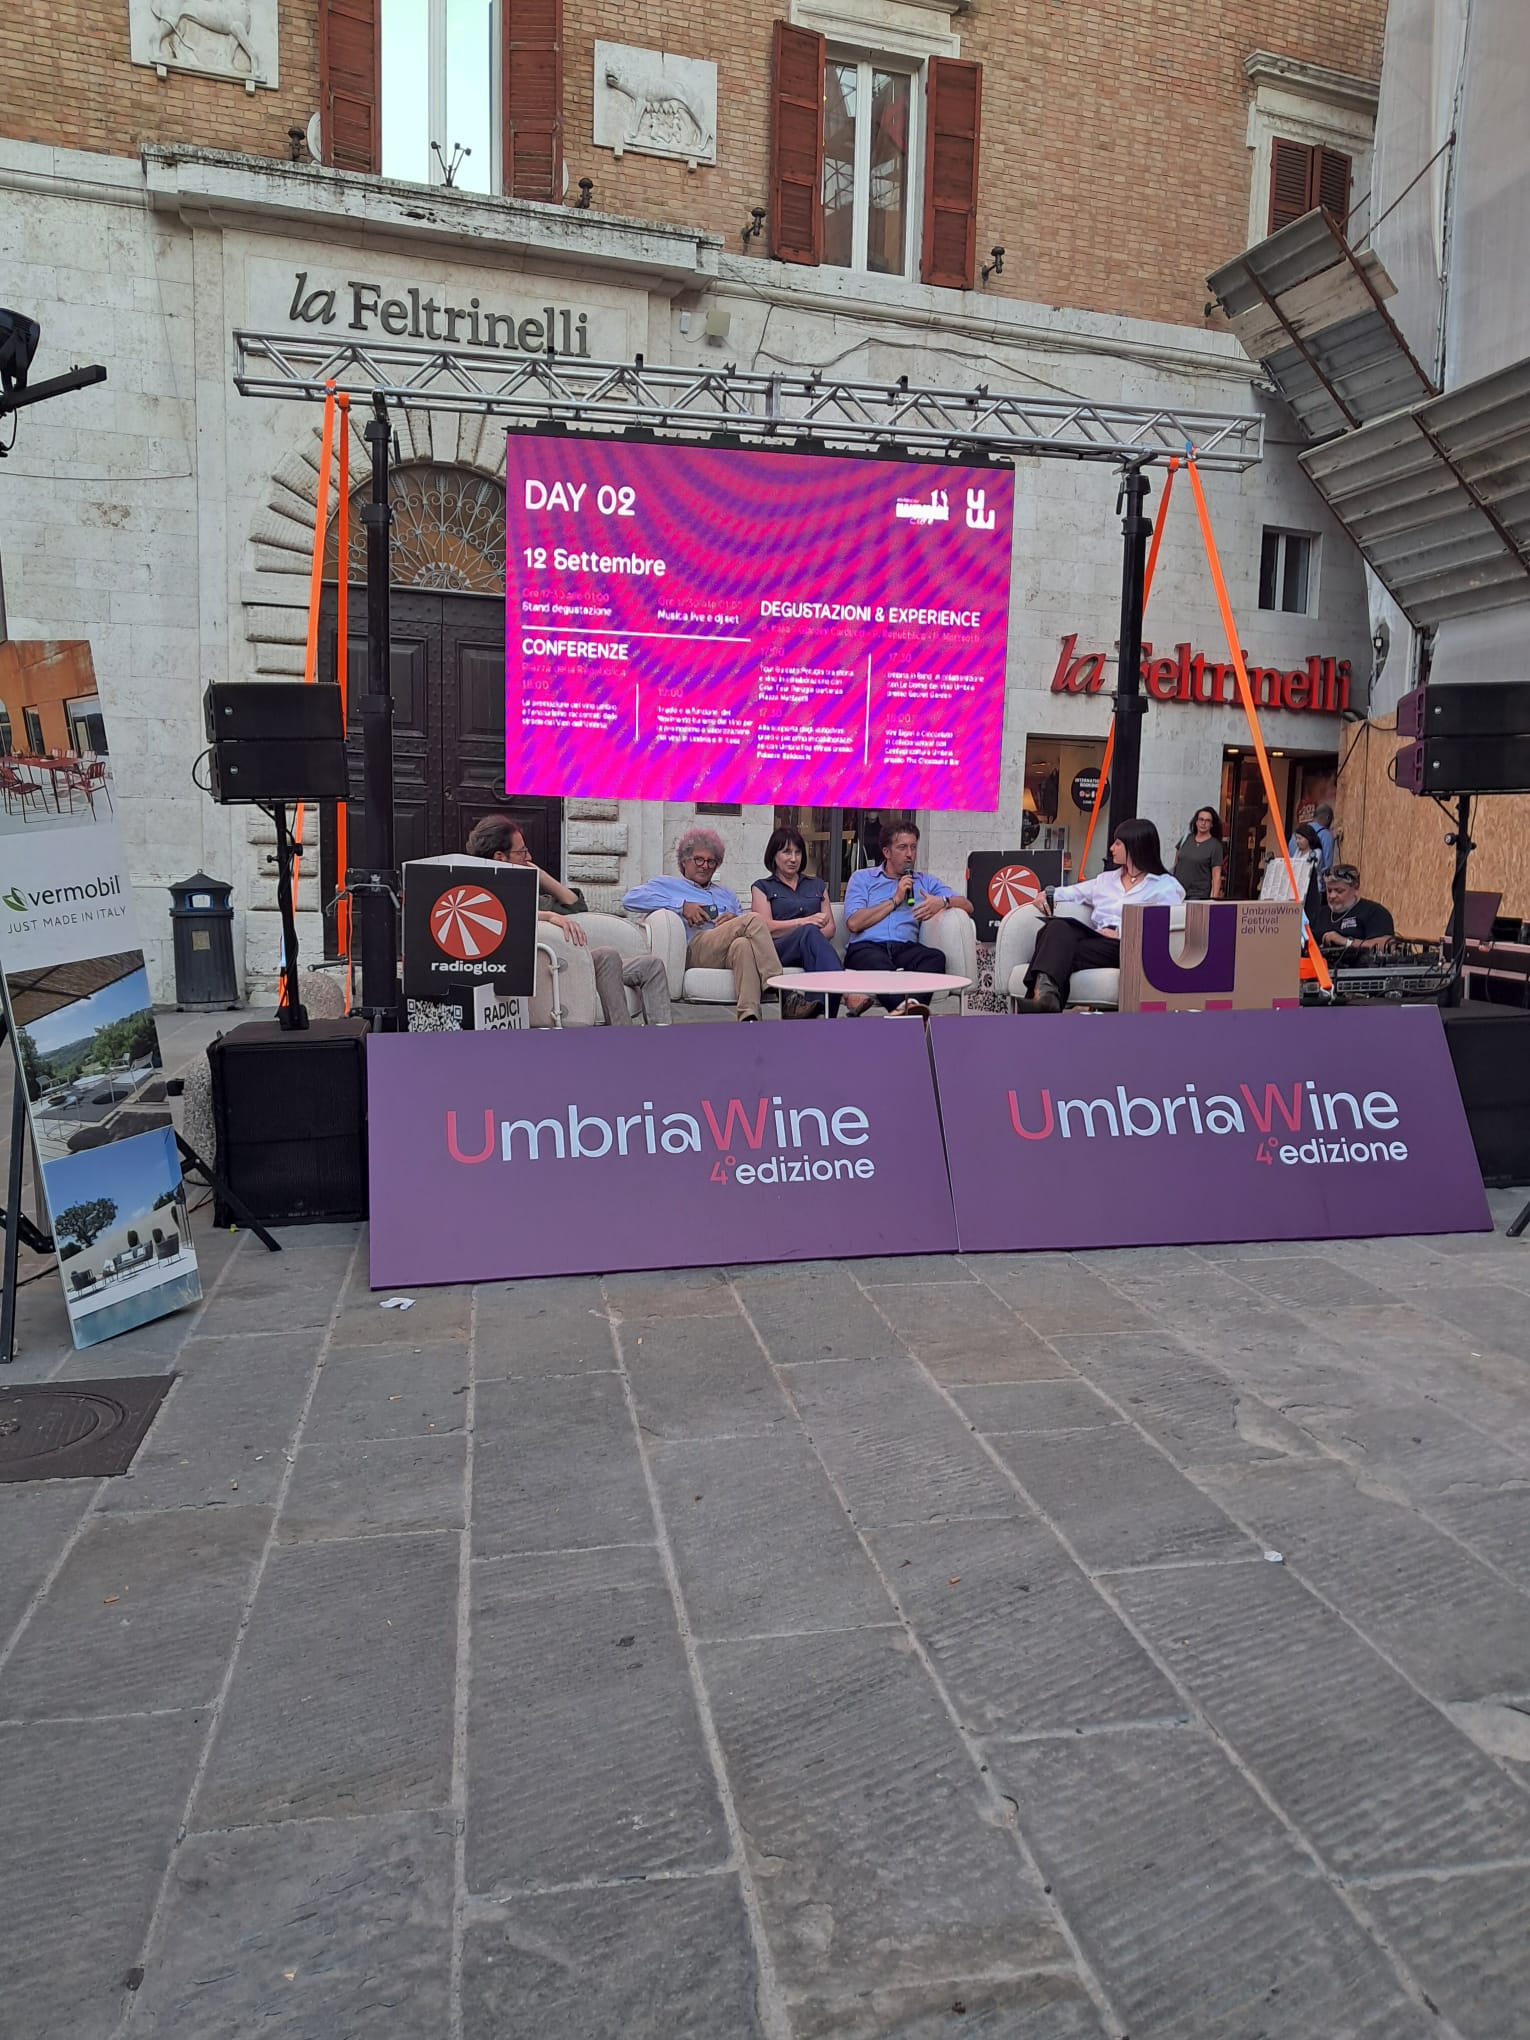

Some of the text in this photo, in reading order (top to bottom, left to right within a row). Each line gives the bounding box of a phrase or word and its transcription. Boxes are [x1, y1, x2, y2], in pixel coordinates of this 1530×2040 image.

[289, 272, 591, 358] la Feltrinelli
[525, 479, 636, 516] DAY 02
[523, 548, 666, 576] 12 Settembre
[522, 601, 613, 616] Stand degustazione
[760, 600, 981, 627] DEGUSTAZIONI & EXPERIENCE
[522, 638, 629, 660] CONFERENZE
[1051, 633, 1107, 695] la
[28, 874, 121, 906] vermobil
[8, 905, 127, 934] JUST MADE IN ITALY
[1241, 906, 1300, 916] UmbriaWine
[1241, 916, 1279, 925] Festival
[1258, 926, 1280, 934] Vino
[431, 960, 507, 975] radioglox
[484, 998, 520, 1024] RADICI
[1008, 1080, 1400, 1141] UmbriaWine
[447, 1096, 870, 1165] UmbriaWine
